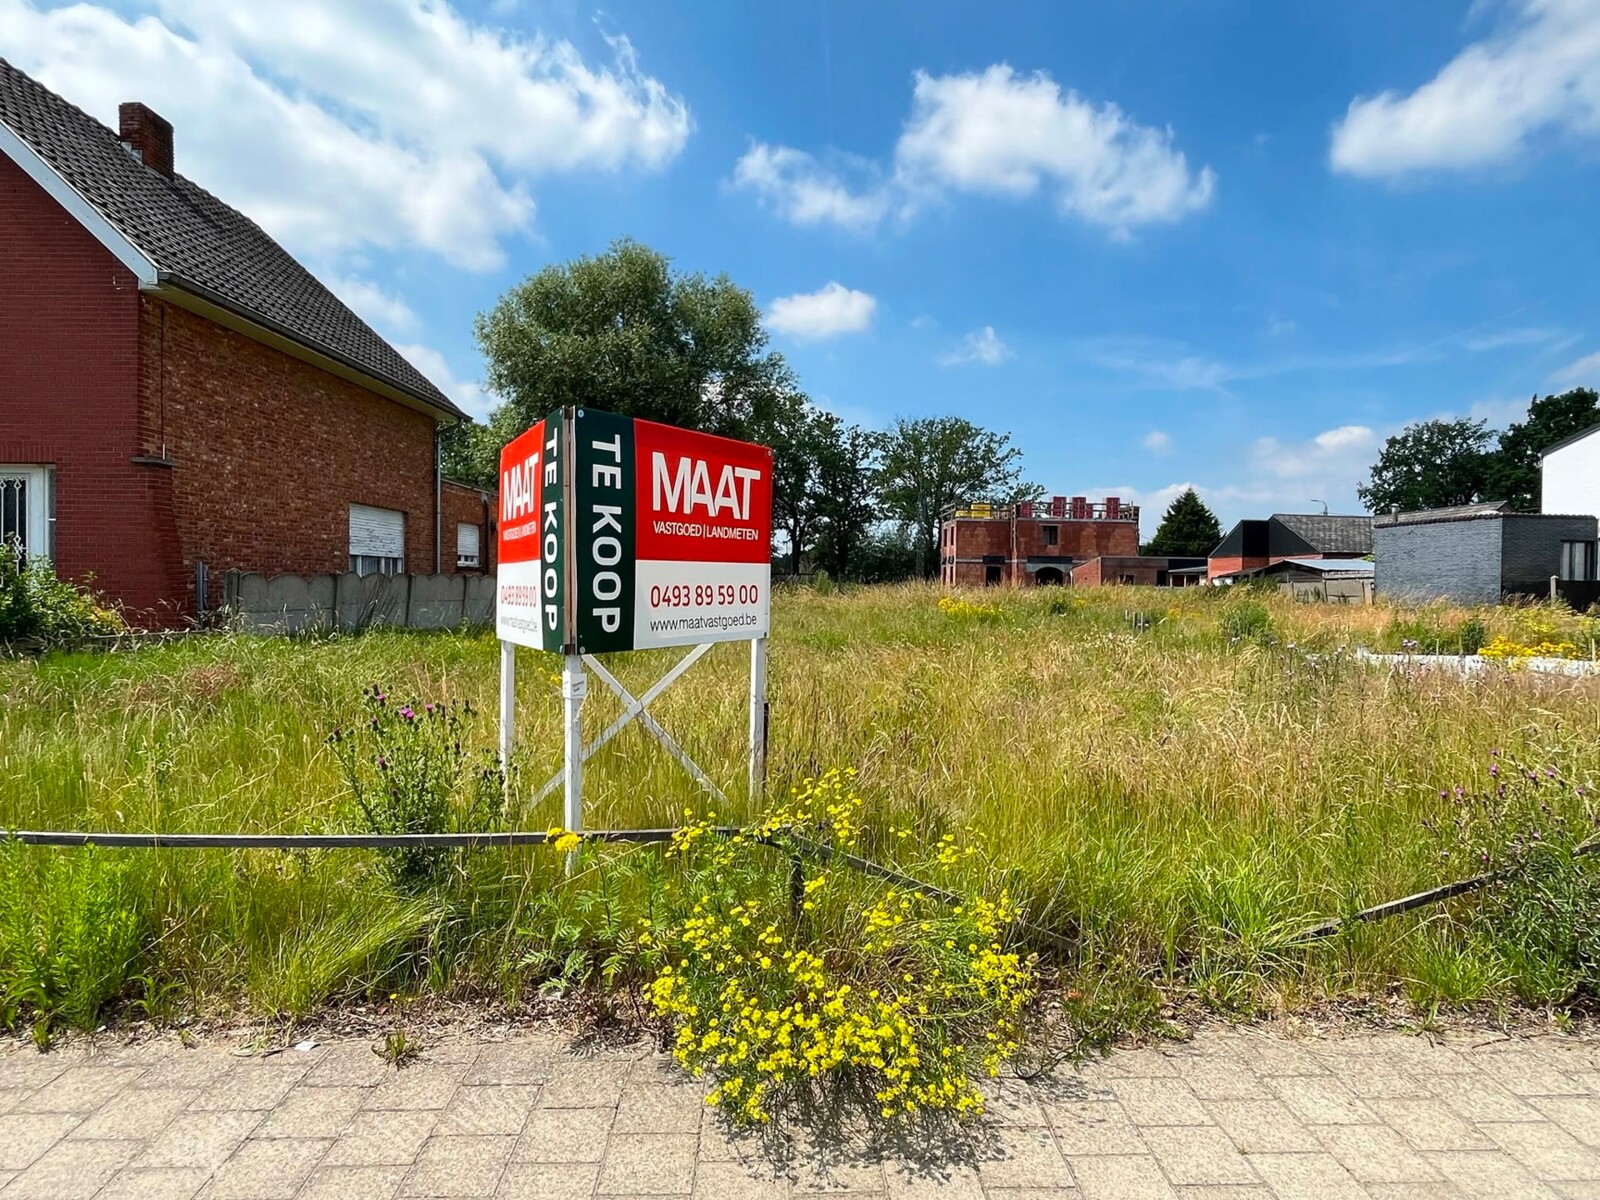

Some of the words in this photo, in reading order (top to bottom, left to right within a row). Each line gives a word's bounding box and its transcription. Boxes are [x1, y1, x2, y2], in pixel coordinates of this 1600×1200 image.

[502, 452, 539, 522] MAAT
[545, 427, 558, 487] TE
[592, 434, 621, 490] TE
[652, 451, 761, 520] MAAT
[544, 501, 558, 631] KOOP
[592, 504, 622, 633] KOOP
[650, 585, 691, 608] 0493
[695, 585, 713, 606] 89
[718, 585, 735, 605] 59
[739, 585, 758, 604] 00
[650, 613, 757, 631] www.maatvastgoed.be
